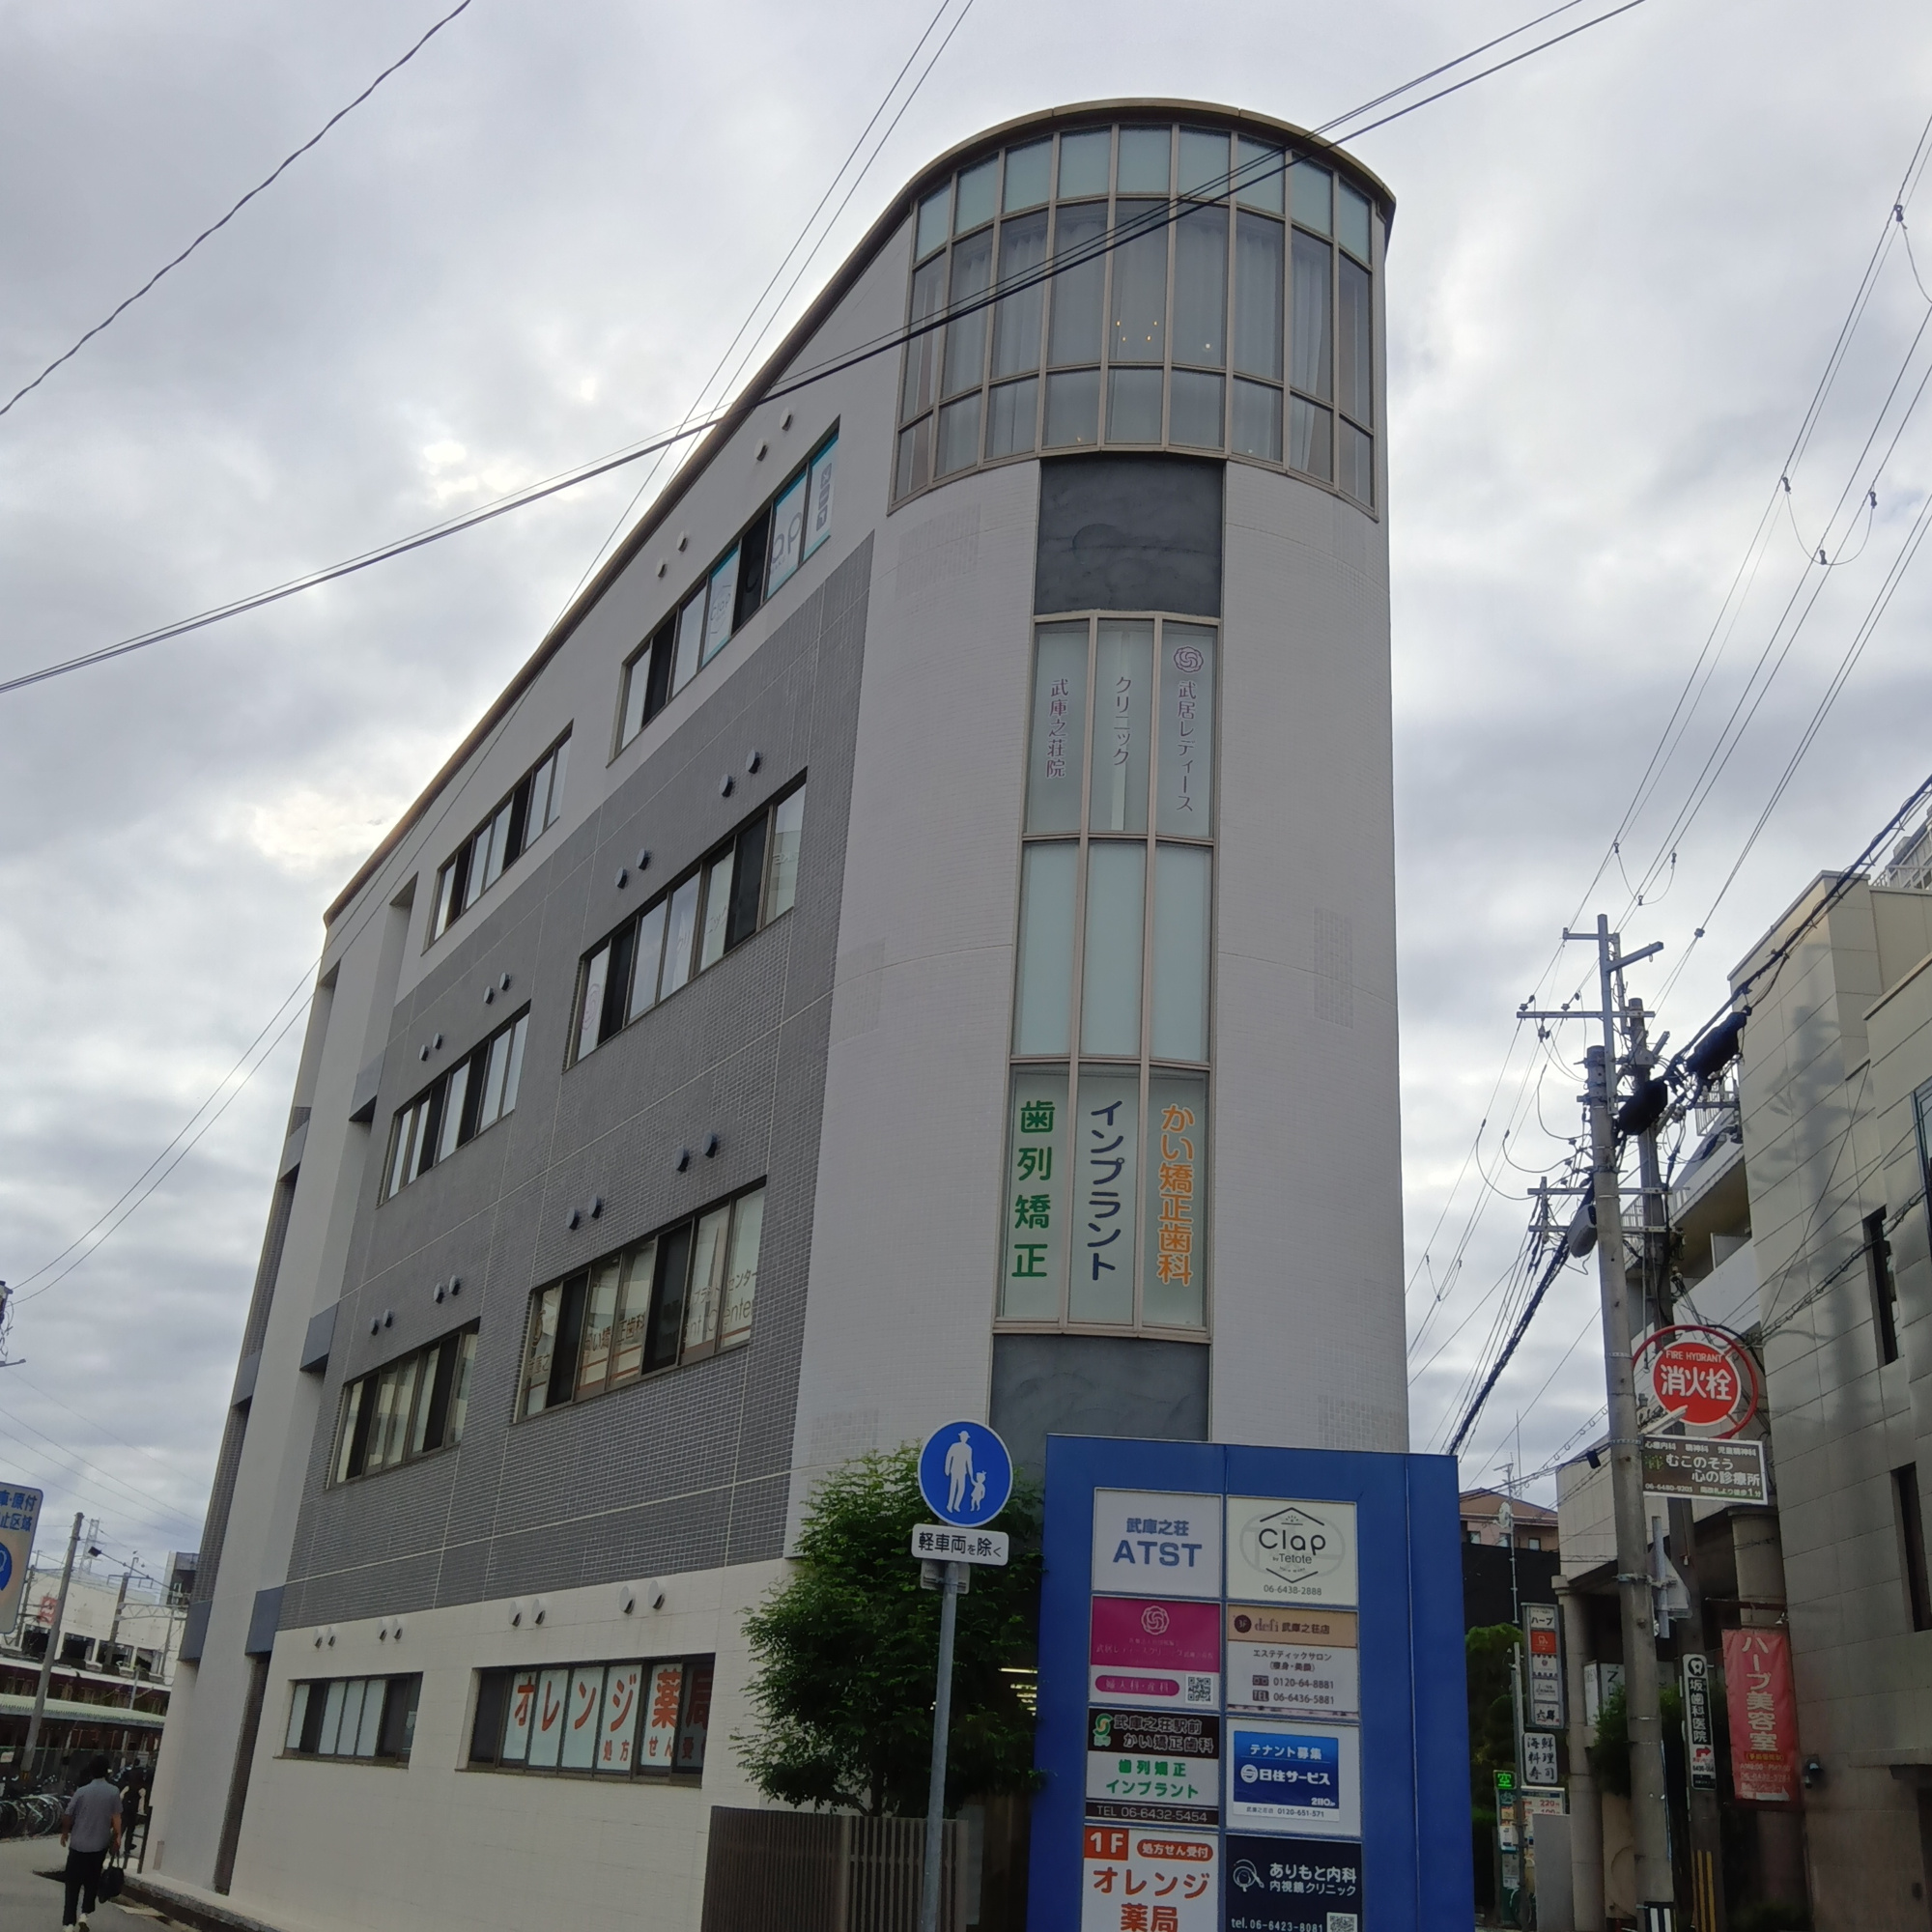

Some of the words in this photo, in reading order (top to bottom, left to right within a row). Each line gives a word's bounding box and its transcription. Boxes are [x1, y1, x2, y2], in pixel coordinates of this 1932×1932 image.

[1046, 679, 1068, 779] 武庫之荘院
[1113, 676, 1131, 766] クリニック
[1177, 681, 1197, 812] 武居レディース
[1011, 1100, 1055, 1277] 歯列矯正
[1087, 1100, 1124, 1281] インプラント
[1156, 1103, 1195, 1287] かい矯正歯科
[1665, 1350, 1683, 1360] FIRE
[1686, 1351, 1722, 1364] HYDRANT
[1660, 1364, 1732, 1401] 消火栓
[1666, 1453, 1734, 1470] むこのそう
[1691, 1468, 1760, 1487] 心の診療所
[1126, 1518, 1189, 1536] 武庫之荘
[919, 1532, 1002, 1557] 軽車両を除く
[1259, 1528, 1326, 1555] Clap
[1113, 1540, 1202, 1567] ATST
[1279, 1553, 1312, 1564] Tetote
[1281, 1622, 1330, 1634] 武庫之荘店
[514, 1668, 713, 1732] オレンジ薬局
[1741, 1636, 1778, 1751] ハーブ美容室
[1690, 1679, 1708, 1743] 坂歯科医院
[1114, 1715, 1202, 1735] 武庫之荘駅前
[603, 1737, 704, 1762] 処方せん受
[1123, 1733, 1214, 1753] かい矯正歯科
[1250, 1744, 1322, 1760] テナント募集
[1119, 1759, 1186, 1776] 歯列矯正
[1260, 1769, 1330, 1785] 日住サービス
[1106, 1779, 1198, 1799] インプラント
[1497, 1772, 1513, 1787] 空
[1096, 1805, 1117, 1816] TEL
[1121, 1806, 1208, 1822] 06-6432-5454
[1090, 1832, 1123, 1854] 1F
[1142, 1842, 1208, 1858] 処方せん受付
[1094, 1866, 1210, 1899] オレンジ
[1269, 1862, 1356, 1884] ありもと内科
[1269, 1881, 1356, 1896] 内視鏡クリニック
[1121, 1902, 1179, 1932] 薬局
